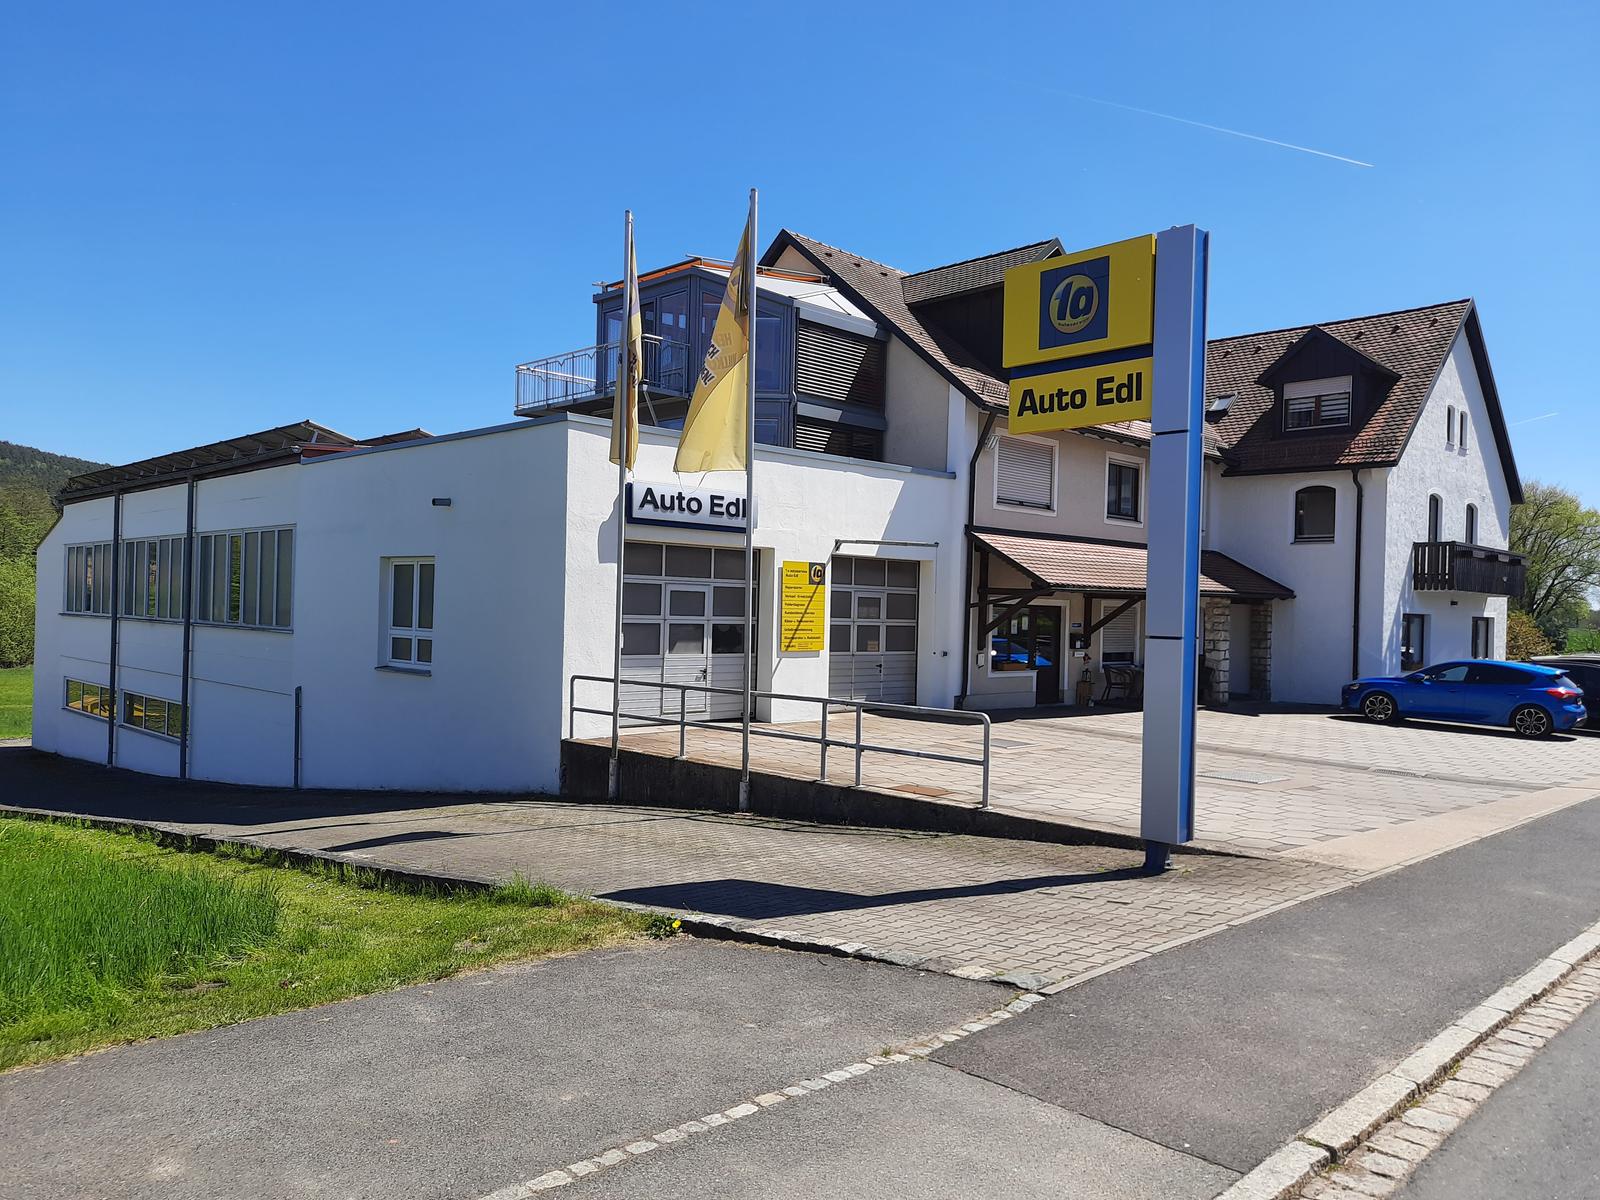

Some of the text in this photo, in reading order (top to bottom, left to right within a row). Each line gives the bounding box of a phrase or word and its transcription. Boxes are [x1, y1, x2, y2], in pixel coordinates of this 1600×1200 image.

[1017, 372, 1143, 417] Auto Edl
[638, 487, 746, 518] Auto Edl
